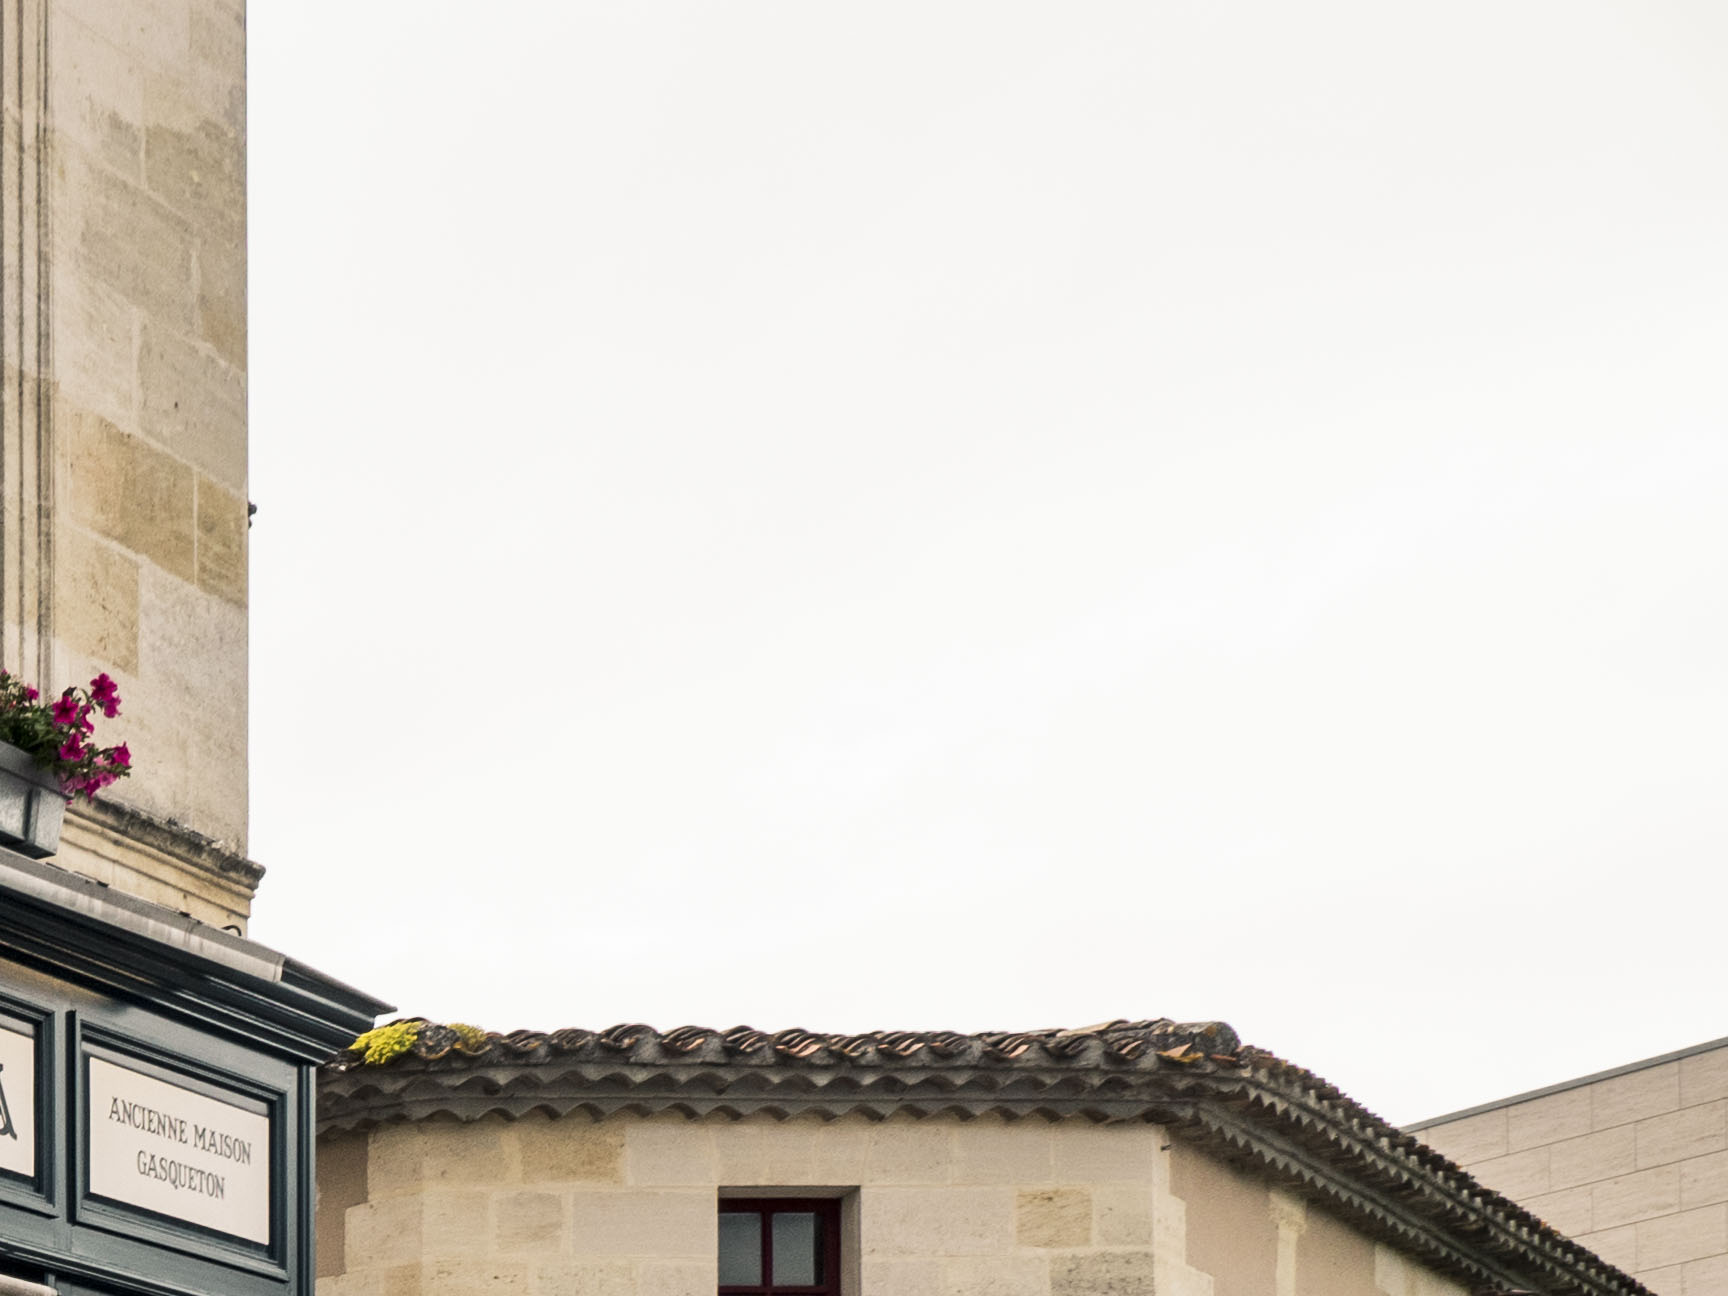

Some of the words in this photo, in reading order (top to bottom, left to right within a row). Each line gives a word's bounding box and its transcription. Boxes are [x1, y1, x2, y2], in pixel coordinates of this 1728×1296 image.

[108, 1096, 189, 1145] ANCIENNE
[192, 1123, 253, 1166] MAISON
[136, 1149, 226, 1200] GASQUETON
